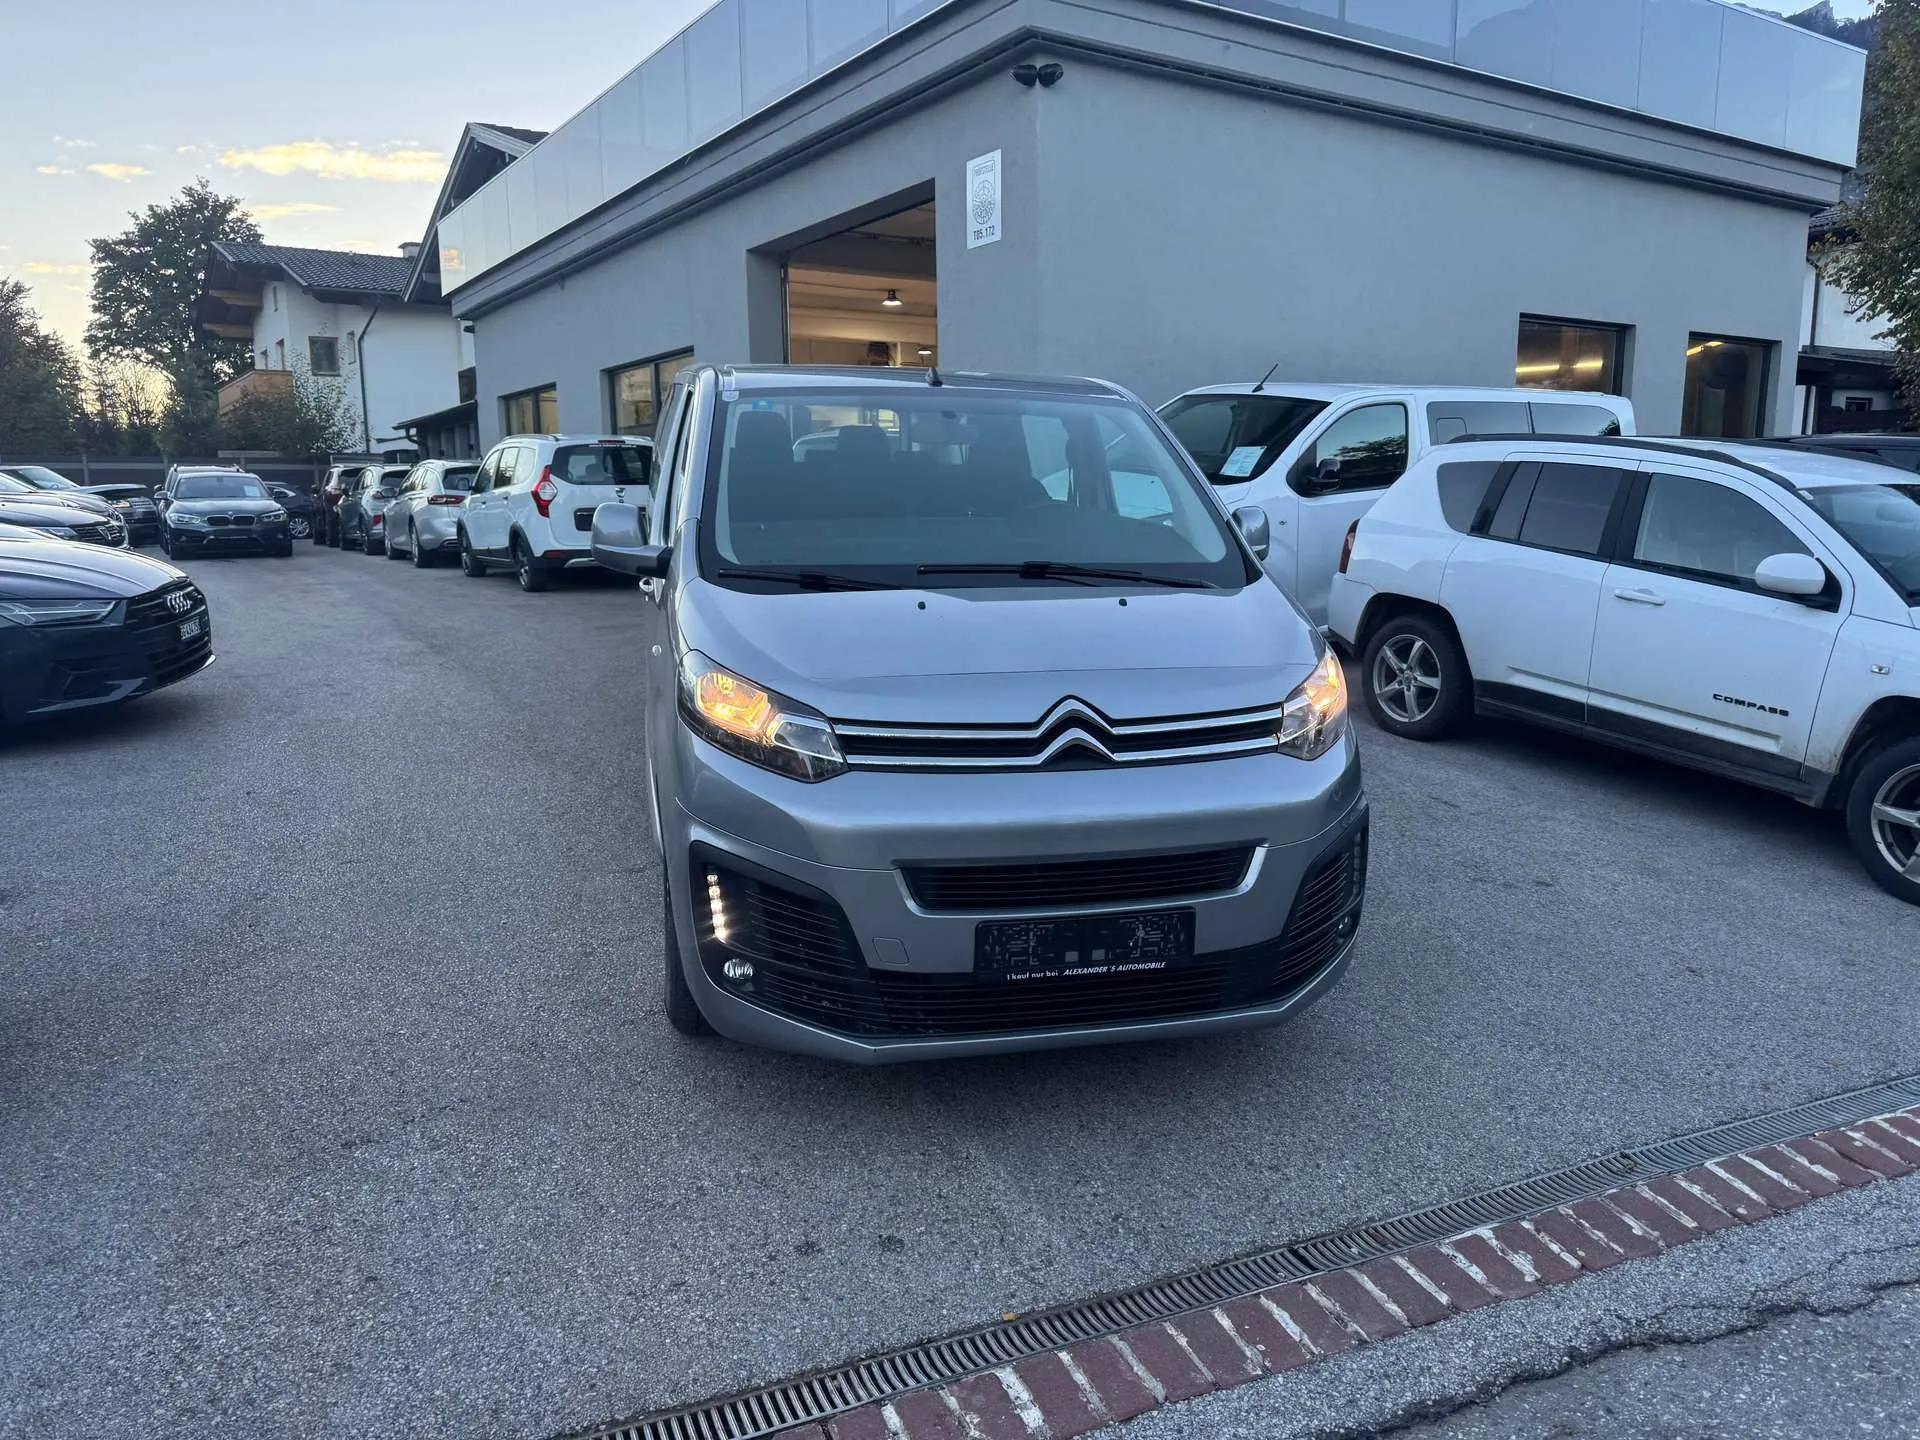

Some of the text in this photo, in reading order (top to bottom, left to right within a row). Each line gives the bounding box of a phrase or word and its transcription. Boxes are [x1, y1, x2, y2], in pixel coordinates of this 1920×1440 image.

[1712, 693, 1789, 717] COMPASS
[1011, 971, 1030, 980] kauf
[1063, 966, 1108, 976] ALEXANDER
[1117, 962, 1166, 972] AUTOMOBILE
